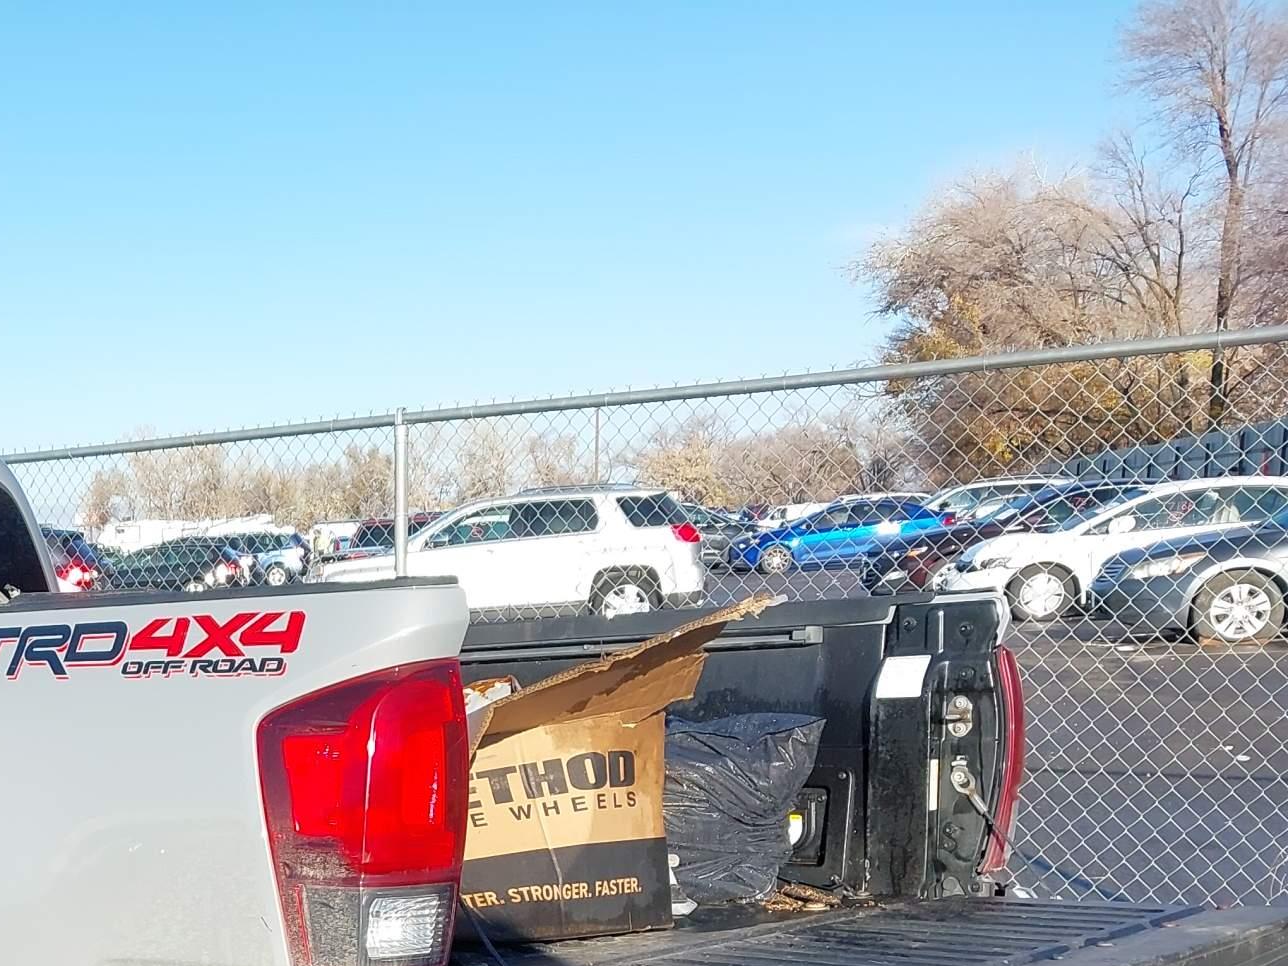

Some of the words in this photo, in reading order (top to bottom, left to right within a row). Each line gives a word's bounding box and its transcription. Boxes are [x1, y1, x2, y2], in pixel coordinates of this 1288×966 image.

[120, 659, 190, 679] OFF
[188, 656, 288, 677] ROAD
[508, 790, 638, 822] WHEELS
[507, 881, 593, 903] STRONGER.
[594, 876, 643, 897] FASTER.
